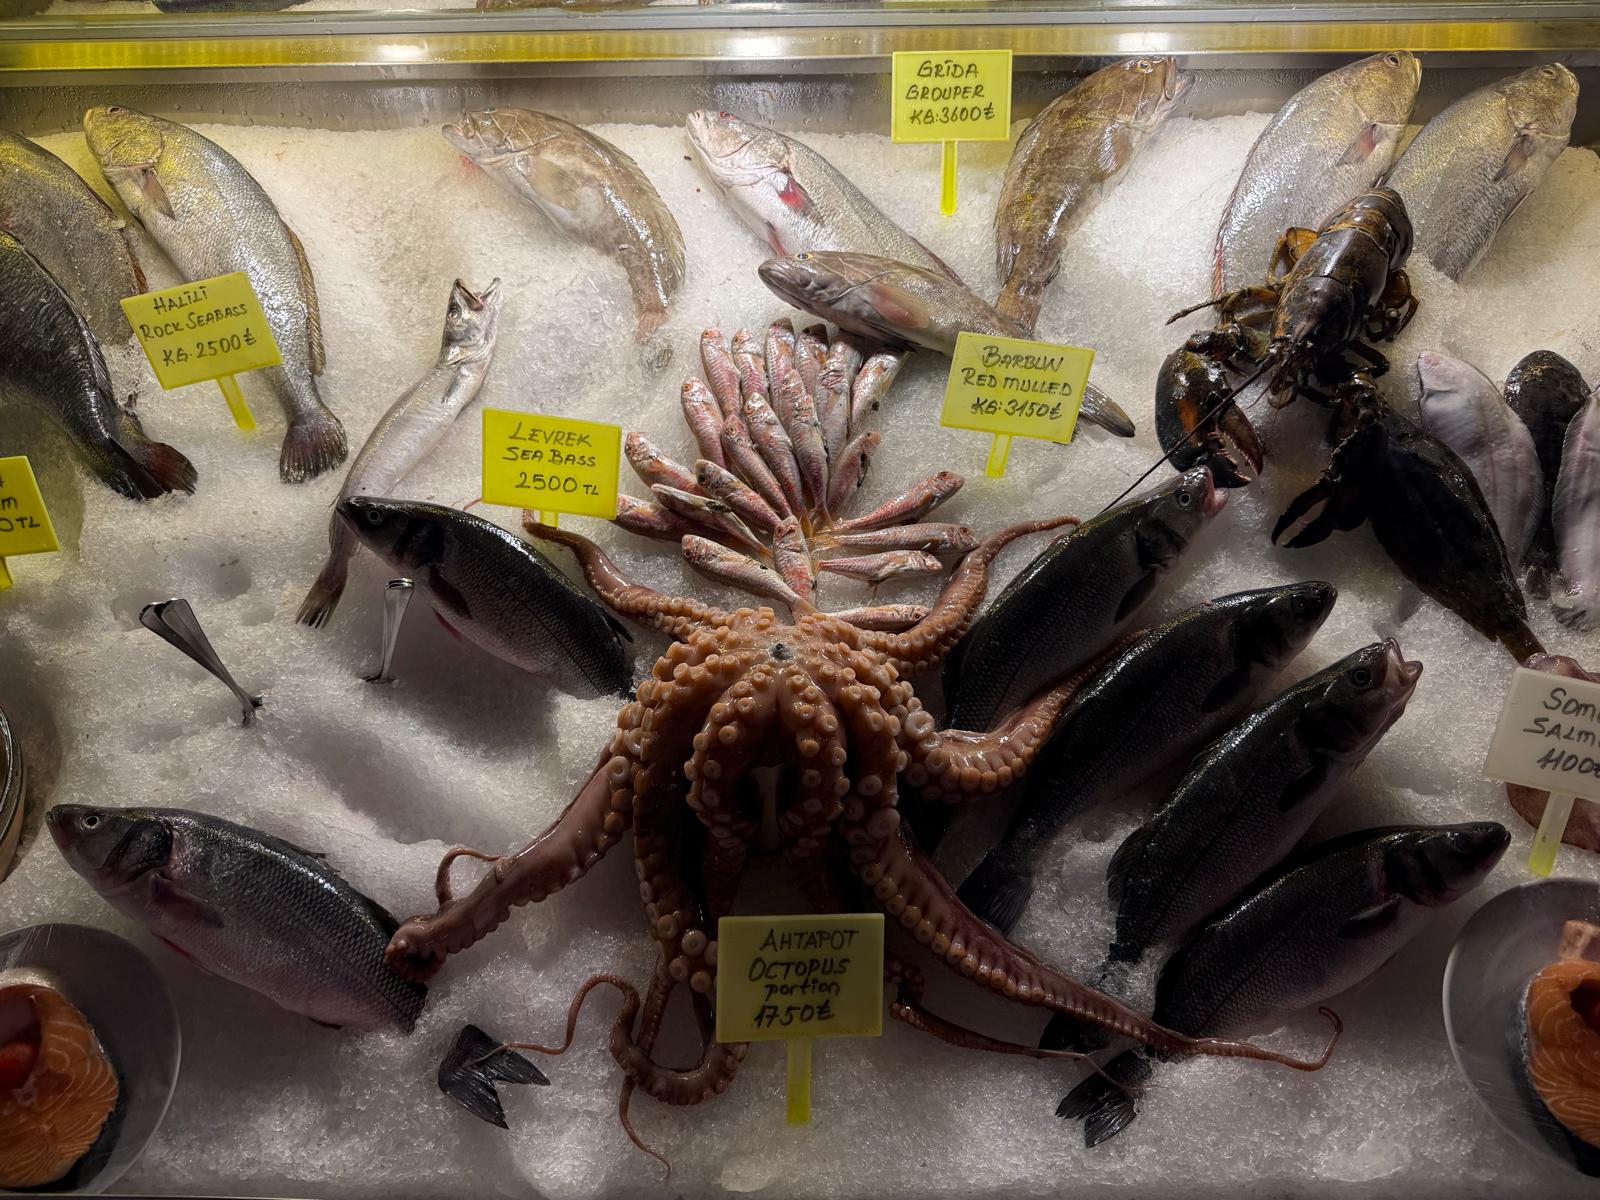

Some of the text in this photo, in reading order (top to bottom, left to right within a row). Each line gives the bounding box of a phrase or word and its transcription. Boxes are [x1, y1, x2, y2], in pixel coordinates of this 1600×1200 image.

[905, 84, 985, 101] GROUPER
[139, 304, 248, 342] ROCK SEABASS
[961, 367, 1072, 396] RED MULLED
[508, 421, 592, 448] LEVREK
[502, 446, 596, 467] SEA BASS
[515, 471, 599, 496] 2500 TL
[1543, 687, 1600, 724] SOM
[1523, 717, 1600, 748] SALM
[760, 928, 859, 952] AHTAPOT
[748, 957, 851, 982] OCTOPUS
[764, 977, 841, 1001] portion
